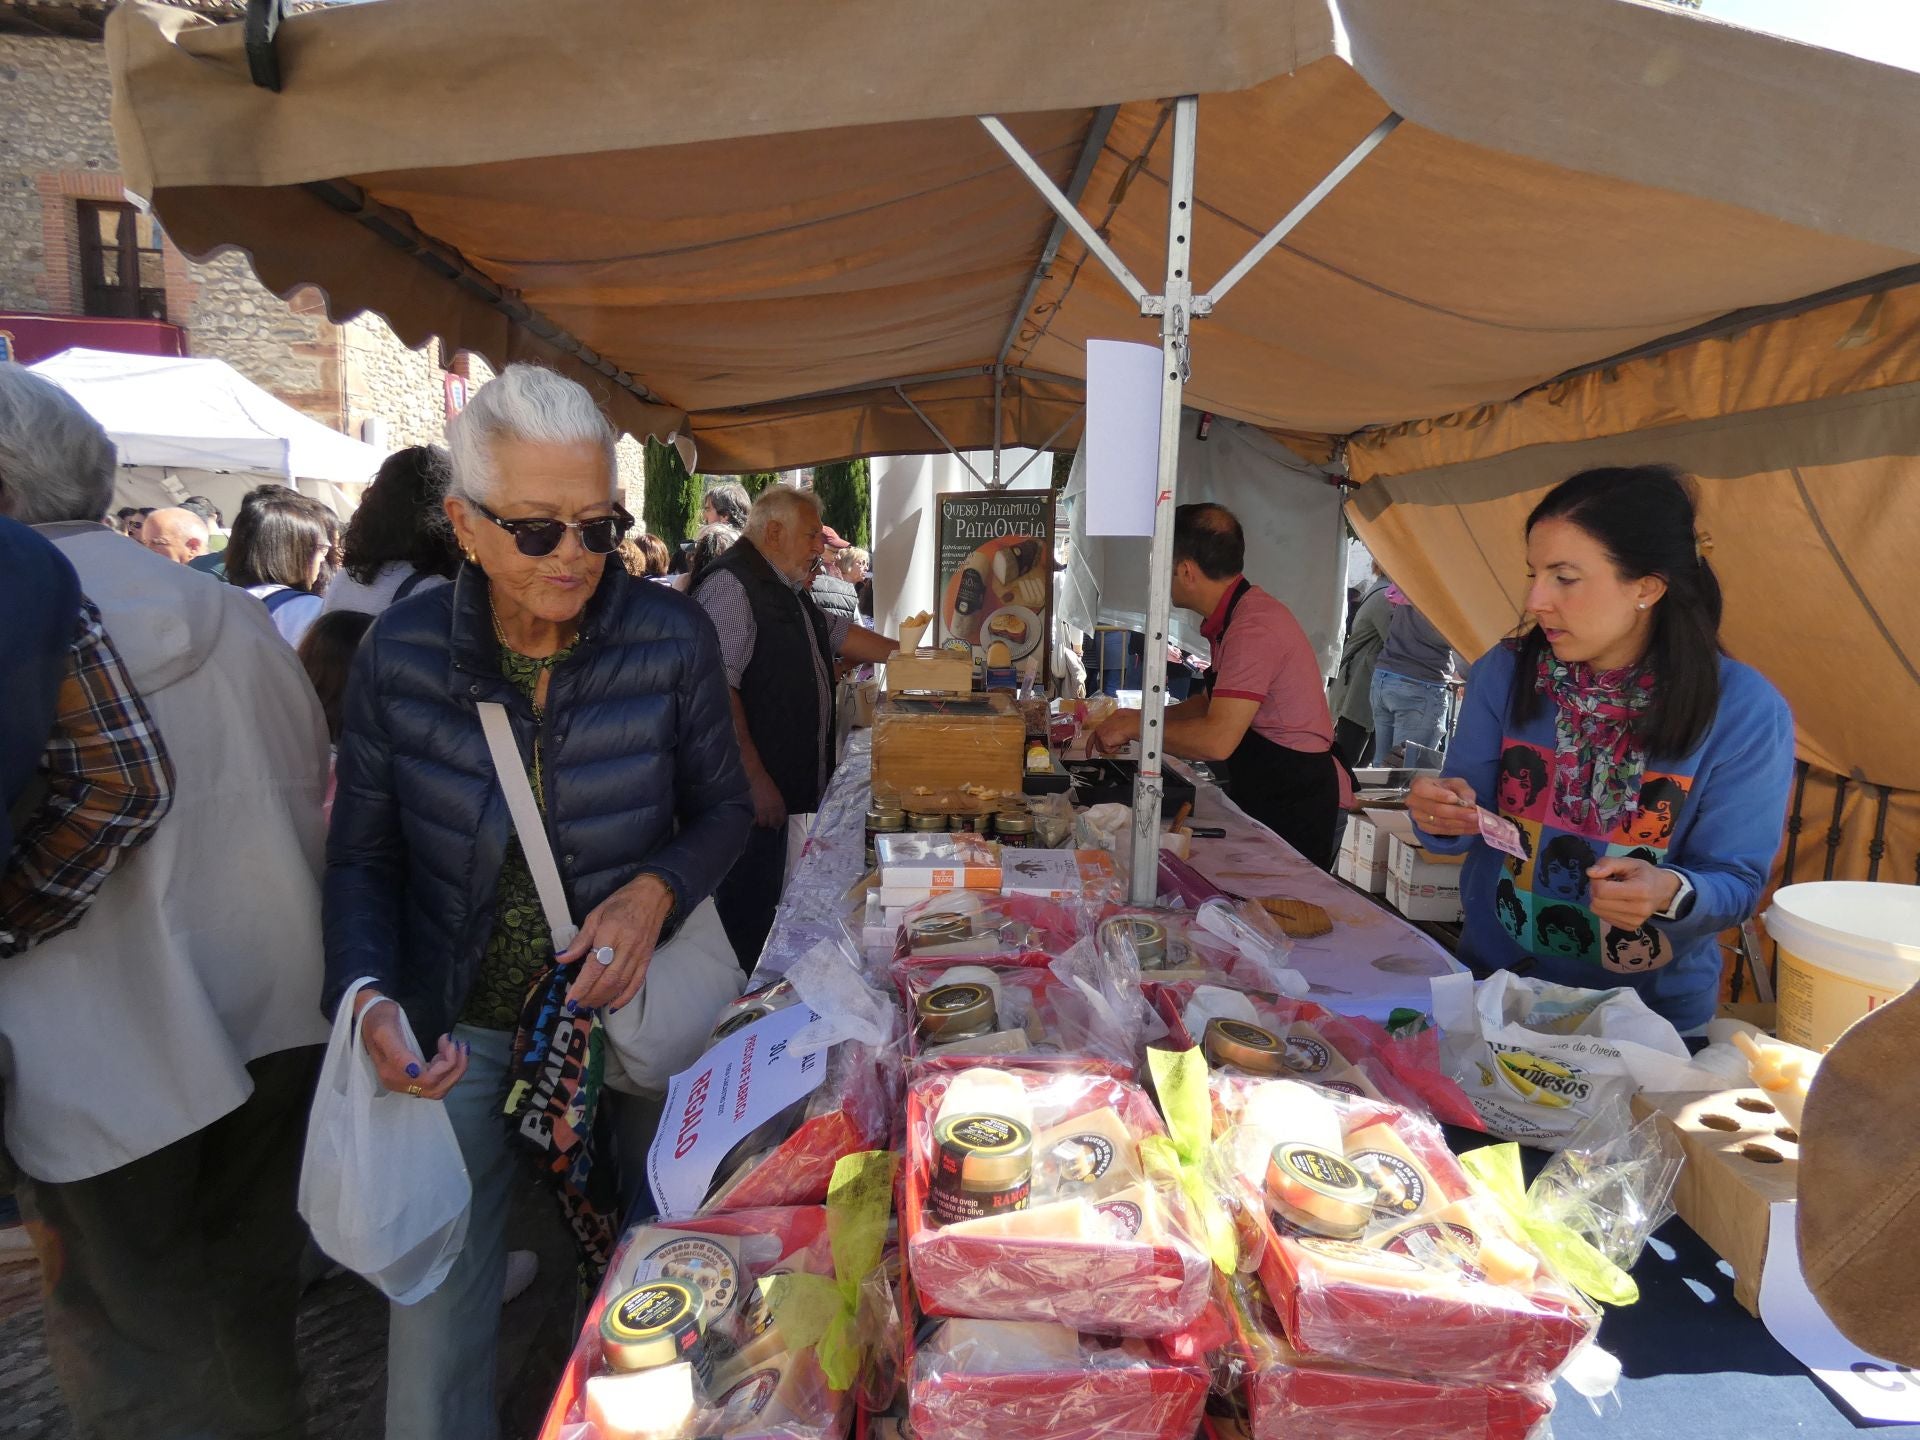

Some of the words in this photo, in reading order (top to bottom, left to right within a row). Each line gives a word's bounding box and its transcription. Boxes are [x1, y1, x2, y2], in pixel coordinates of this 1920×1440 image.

[943, 502, 979, 519] QUESO
[981, 501, 1040, 516] PATAMULO
[769, 1039, 787, 1057] 30
[1572, 1041, 1587, 1053] de
[1590, 1043, 1621, 1058] Oveja
[674, 1068, 713, 1160] REGALO
[1084, 1137, 1105, 1147] QUESO
[1103, 1145, 1110, 1154] DE
[1095, 1153, 1110, 1175] OVEJA
[1373, 1154, 1404, 1168] QUESO
[1403, 1167, 1415, 1177] DE
[1411, 1178, 1421, 1202] OVEJA
[938, 1199, 956, 1211] aceite
[957, 1205, 966, 1214] de
[967, 1207, 984, 1216] oliva
[950, 1195, 958, 1204] de
[960, 1198, 978, 1208] oveja
[1112, 1205, 1132, 1217] QUESO
[1450, 1230, 1471, 1244] UESO
[658, 1243, 690, 1259] QUESO
